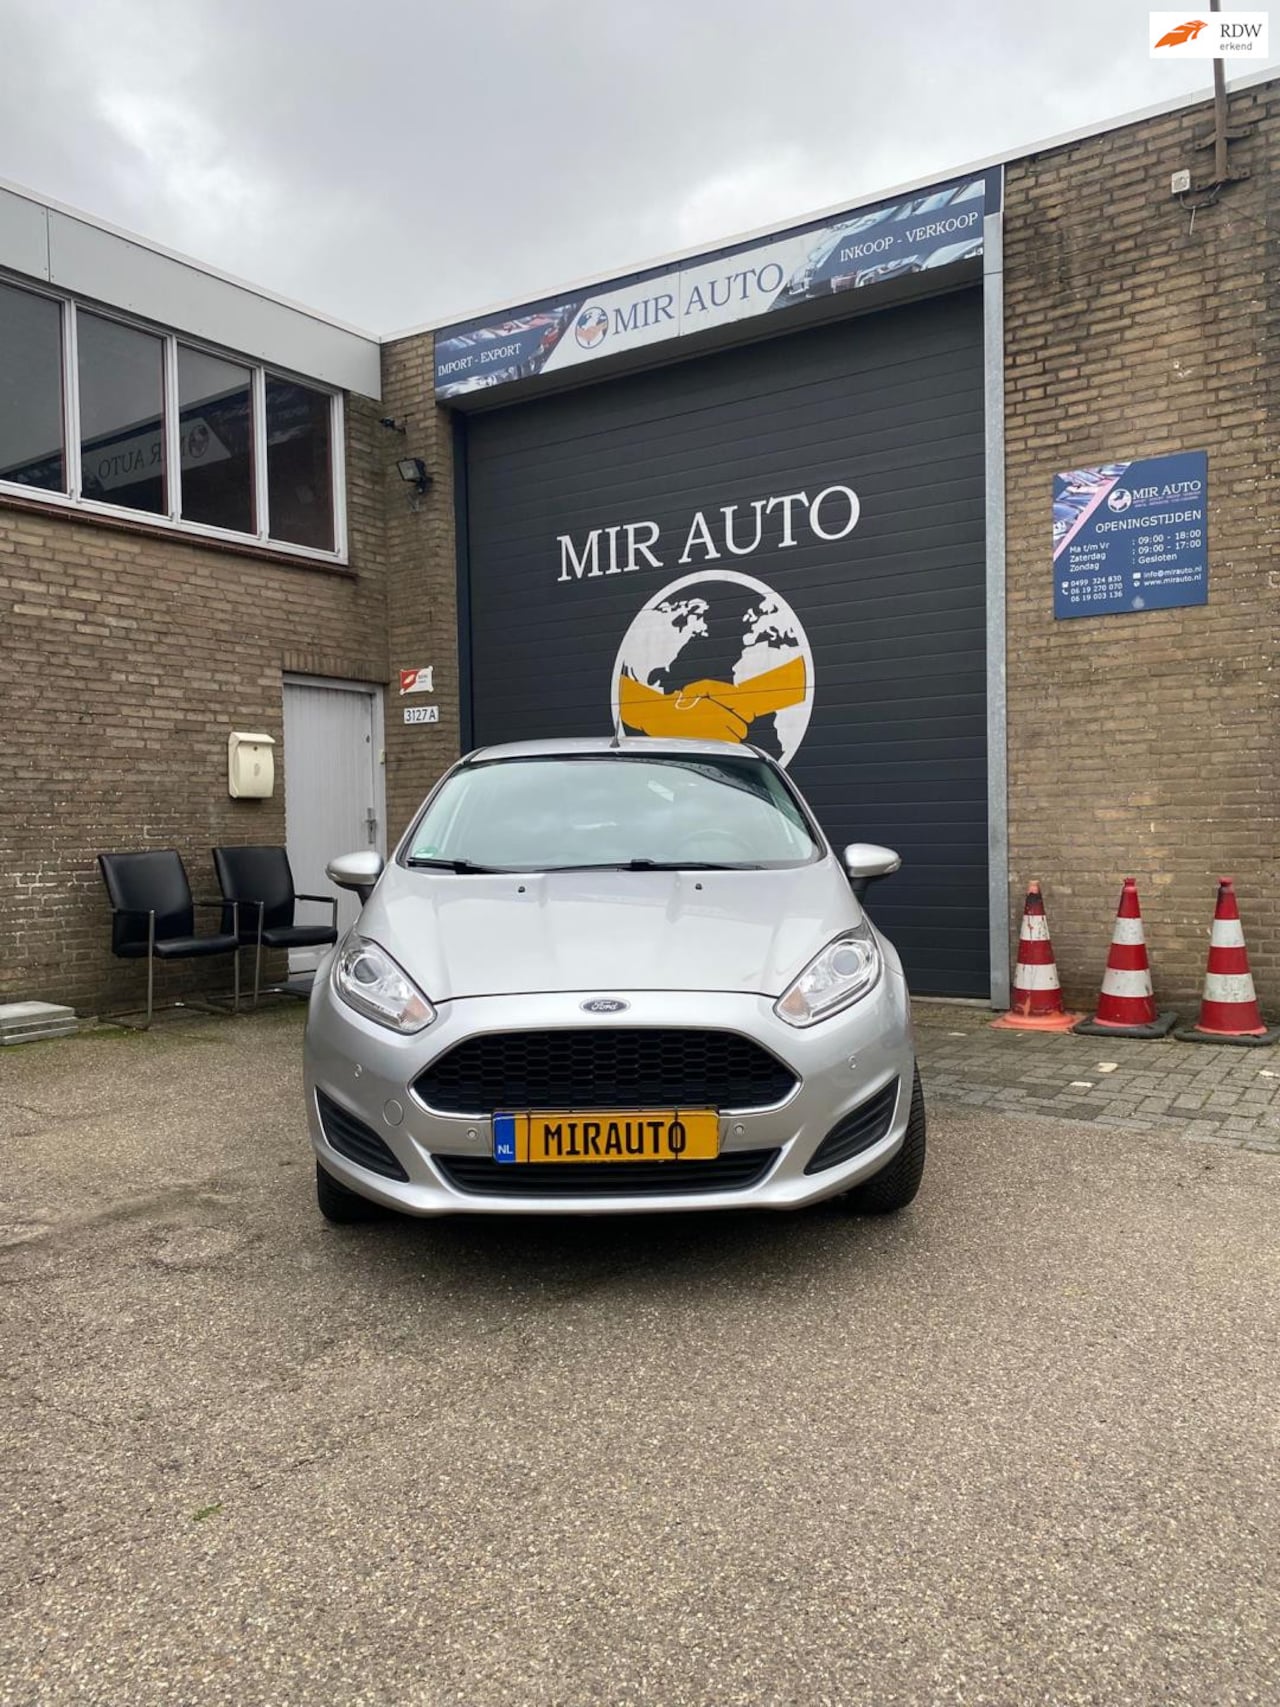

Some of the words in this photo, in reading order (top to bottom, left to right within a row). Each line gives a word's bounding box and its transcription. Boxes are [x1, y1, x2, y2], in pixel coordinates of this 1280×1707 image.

[840, 236, 894, 262] INKOOP
[905, 211, 979, 243] VERKOOP
[612, 293, 675, 335] MIR
[684, 263, 783, 316] AUTO
[438, 355, 473, 376] IMPORT
[480, 343, 521, 364] EXPORT
[1132, 486, 1159, 500] MIR
[1162, 480, 1201, 496] AUTO
[556, 520, 664, 582] MIR
[678, 485, 861, 564] AUTO
[1095, 509, 1202, 534] OPENINGSTIJDEN
[1070, 545, 1081, 553] Ma
[1099, 542, 1110, 550] Vr
[1138, 534, 1164, 545] 09:00
[1175, 529, 1201, 540] 18:00
[1070, 552, 1107, 563] Zaterdag
[1138, 543, 1164, 555] 09:00
[1175, 539, 1201, 550] 17:00
[1070, 562, 1100, 573] Zondag
[1138, 553, 1178, 564] Gesloten
[1143, 565, 1202, 579] info@mirauto.nl
[1071, 579, 1089, 587] 0499
[1144, 574, 1202, 586] www.mirauto.nl
[1082, 593, 1091, 601] 19
[498, 1144, 513, 1155] NL
[543, 1120, 687, 1156] MIRAUTO
